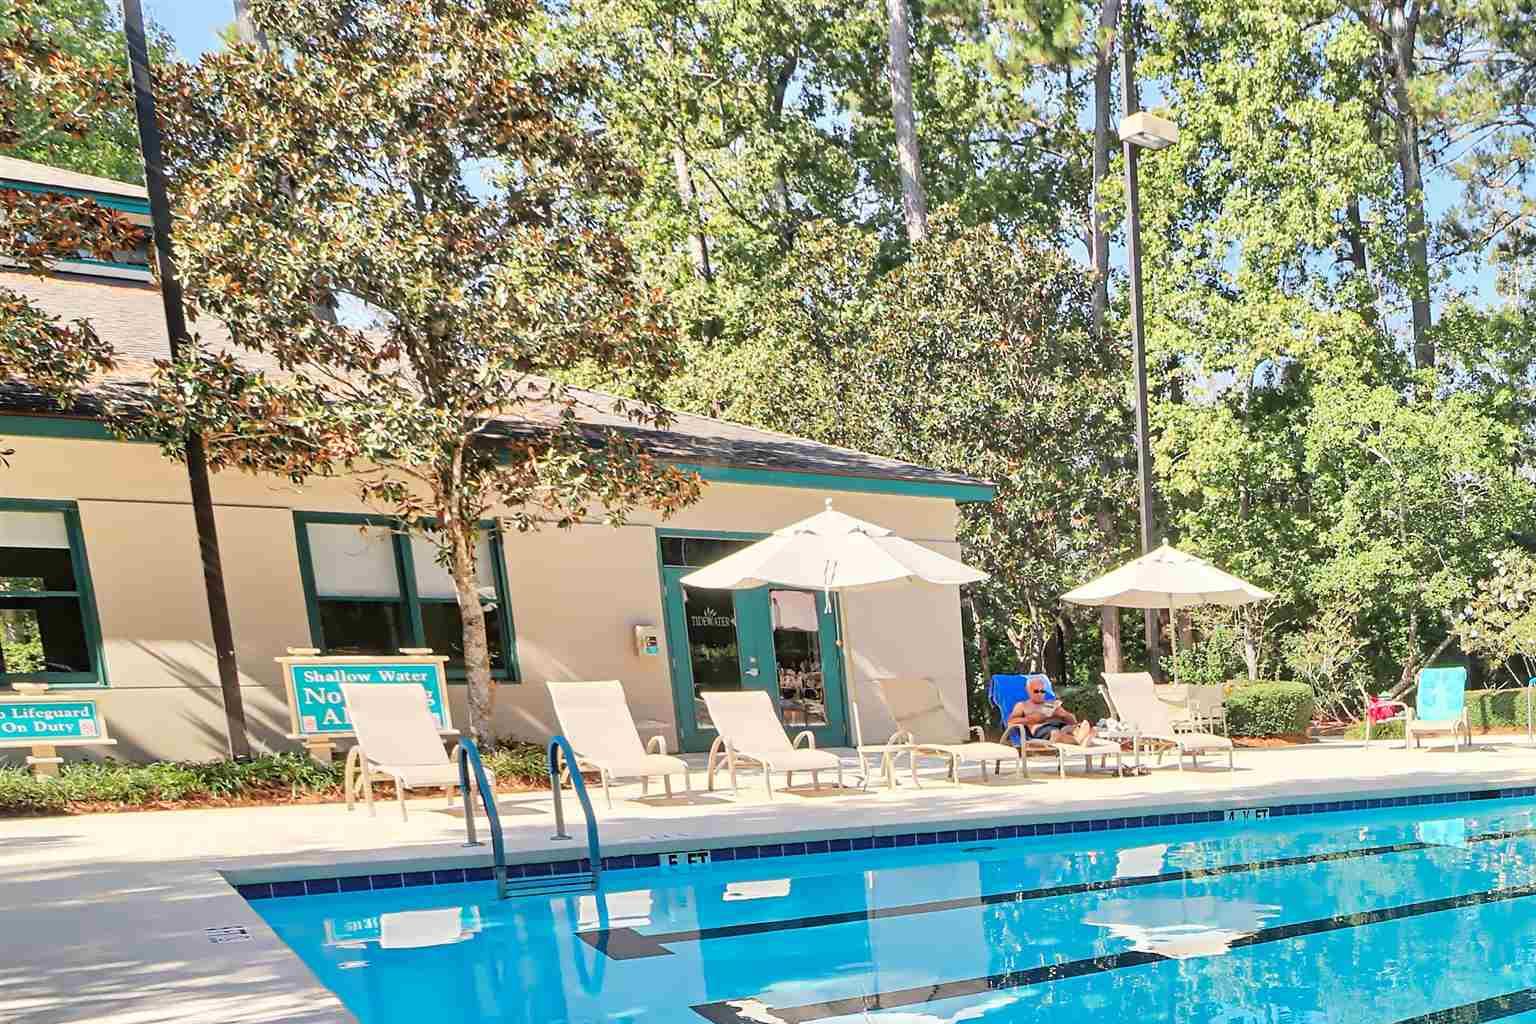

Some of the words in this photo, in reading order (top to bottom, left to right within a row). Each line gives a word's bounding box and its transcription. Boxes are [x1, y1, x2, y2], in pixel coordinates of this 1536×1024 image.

[303, 670, 371, 682] Shallow
[378, 671, 428, 682] Water
[303, 687, 341, 704] No
[11, 706, 89, 720] Lifeguard
[1, 722, 27, 733] On
[33, 721, 74, 734] Duty
